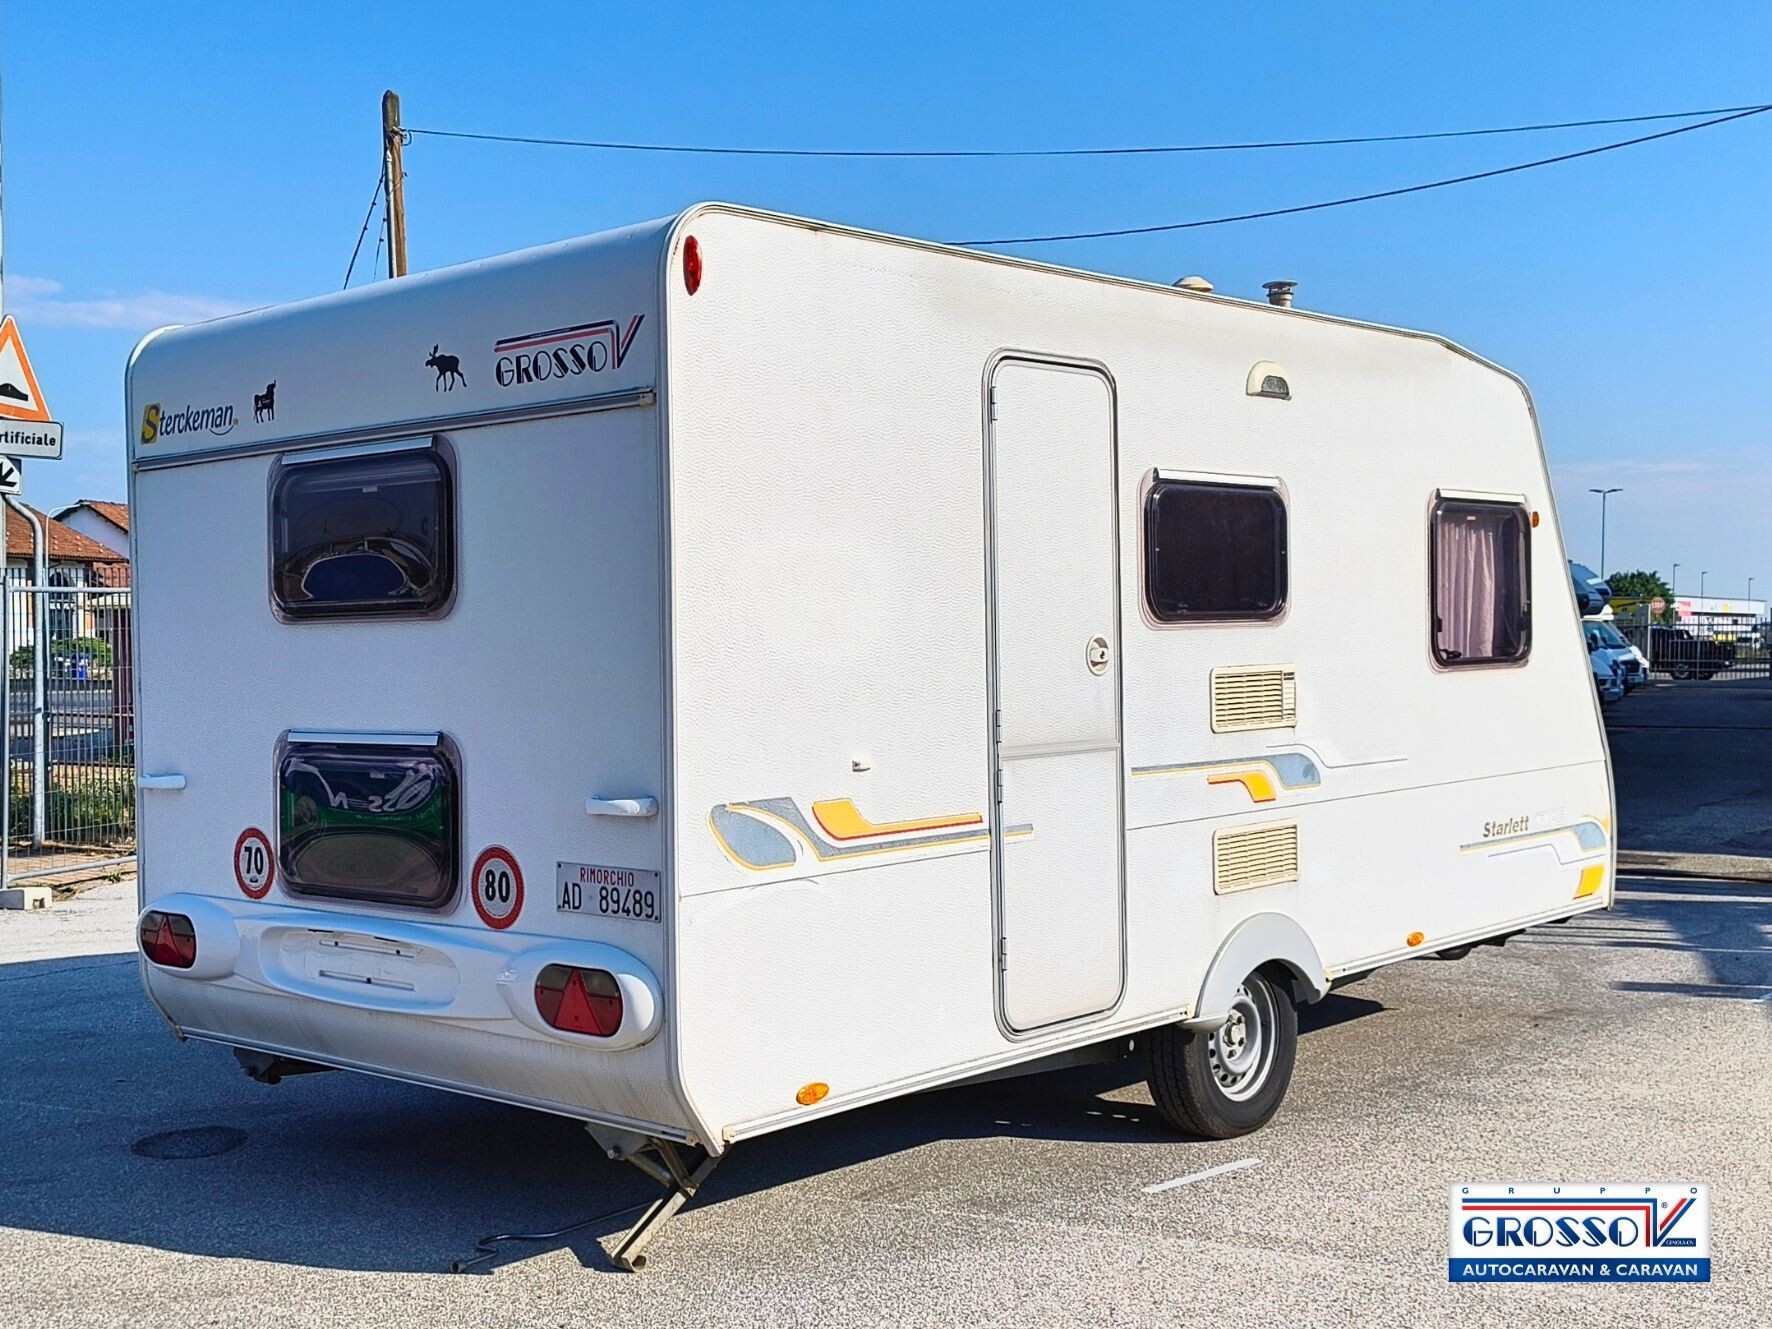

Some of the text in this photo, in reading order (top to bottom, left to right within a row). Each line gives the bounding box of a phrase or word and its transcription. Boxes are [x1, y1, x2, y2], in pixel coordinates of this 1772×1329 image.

[495, 340, 608, 387] GROSSO
[141, 404, 234, 444] Sterckeman
[1482, 815, 1530, 838] Starlett
[244, 846, 264, 876] 70
[580, 867, 635, 888] RIMORCHIO
[484, 868, 510, 904] 80
[561, 881, 655, 919] AD 89489
